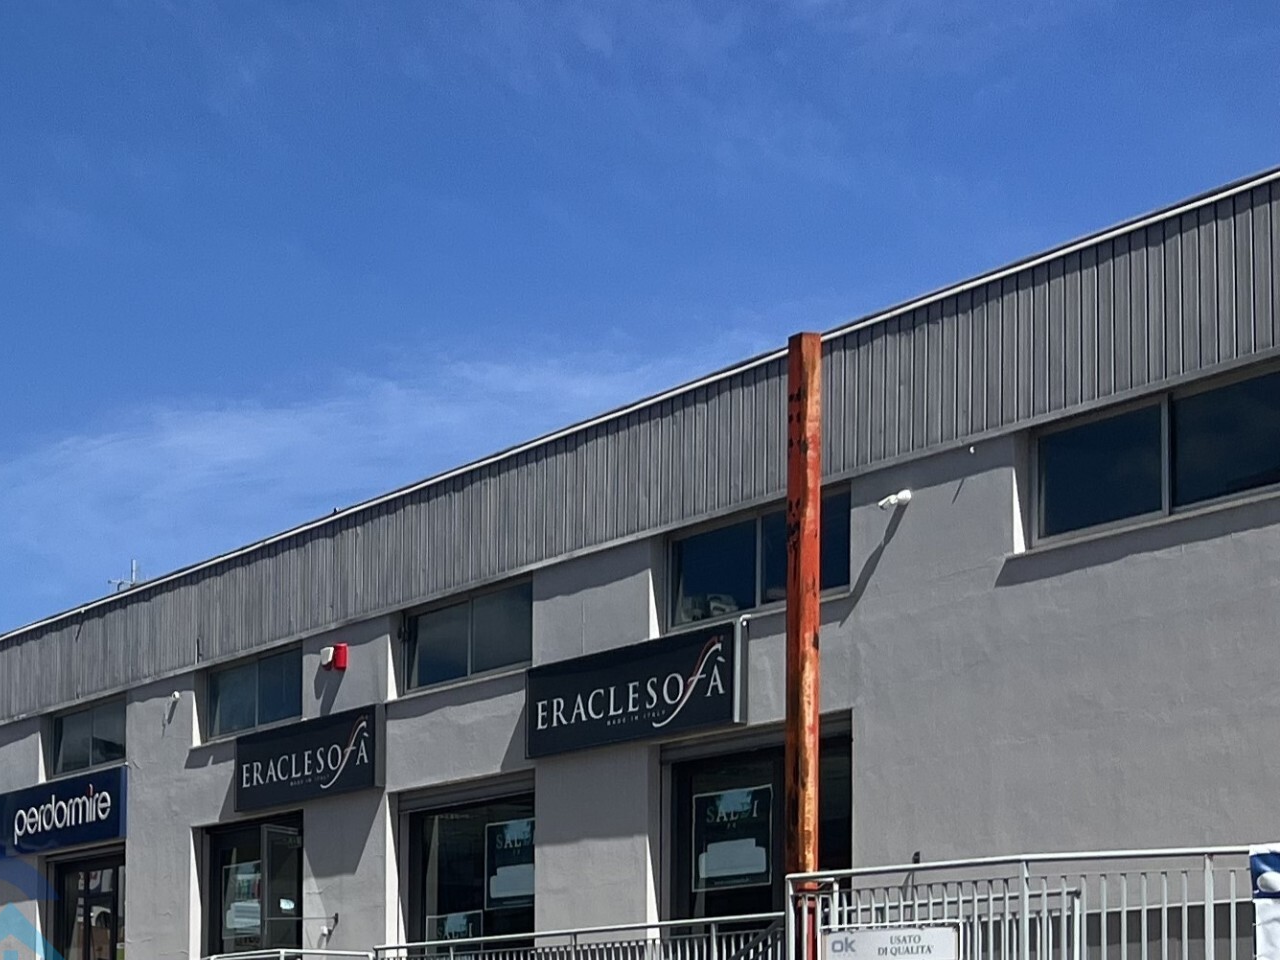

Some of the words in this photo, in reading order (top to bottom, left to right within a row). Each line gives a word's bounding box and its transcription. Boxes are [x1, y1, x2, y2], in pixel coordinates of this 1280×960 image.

[13, 784, 112, 845] perdormire
[889, 934, 922, 945] USATO
[877, 946, 888, 956] DI
